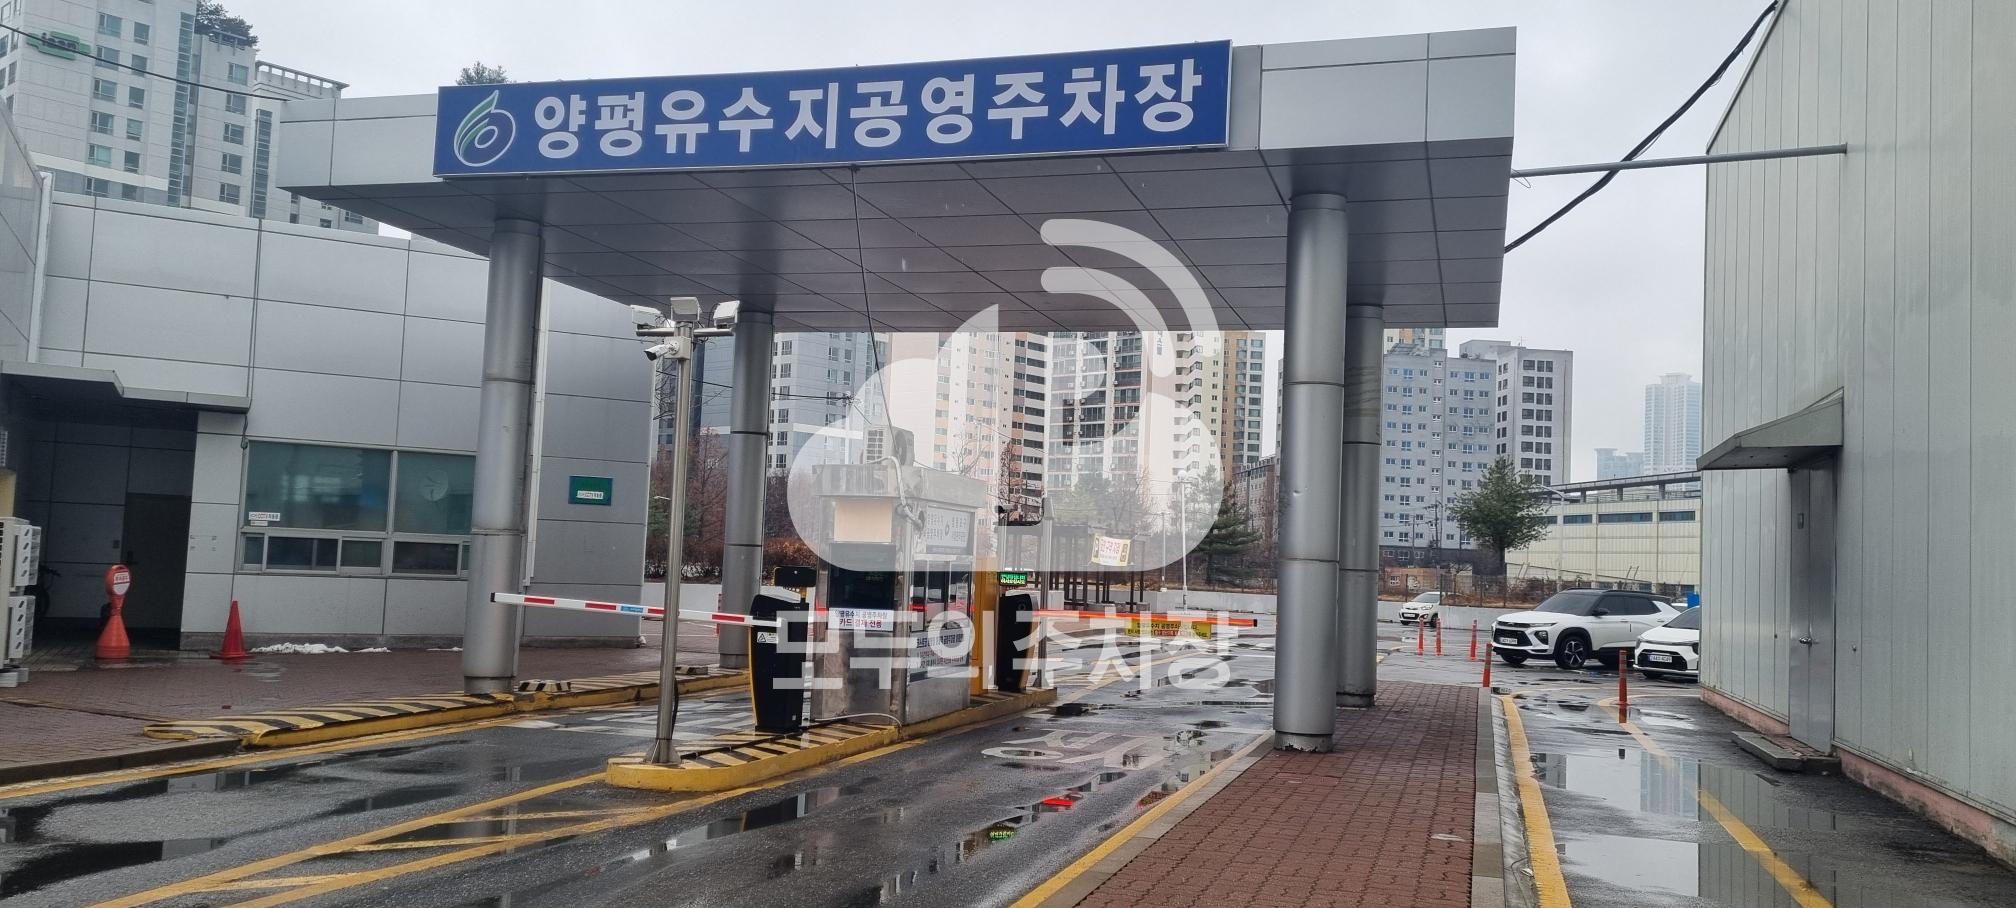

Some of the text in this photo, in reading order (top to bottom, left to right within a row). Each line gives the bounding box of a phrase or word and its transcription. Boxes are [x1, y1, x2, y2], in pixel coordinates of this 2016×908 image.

[534, 58, 1202, 159] 양평유수지공영주차장
[840, 618, 853, 626] 카드
[869, 620, 882, 628] 전용
